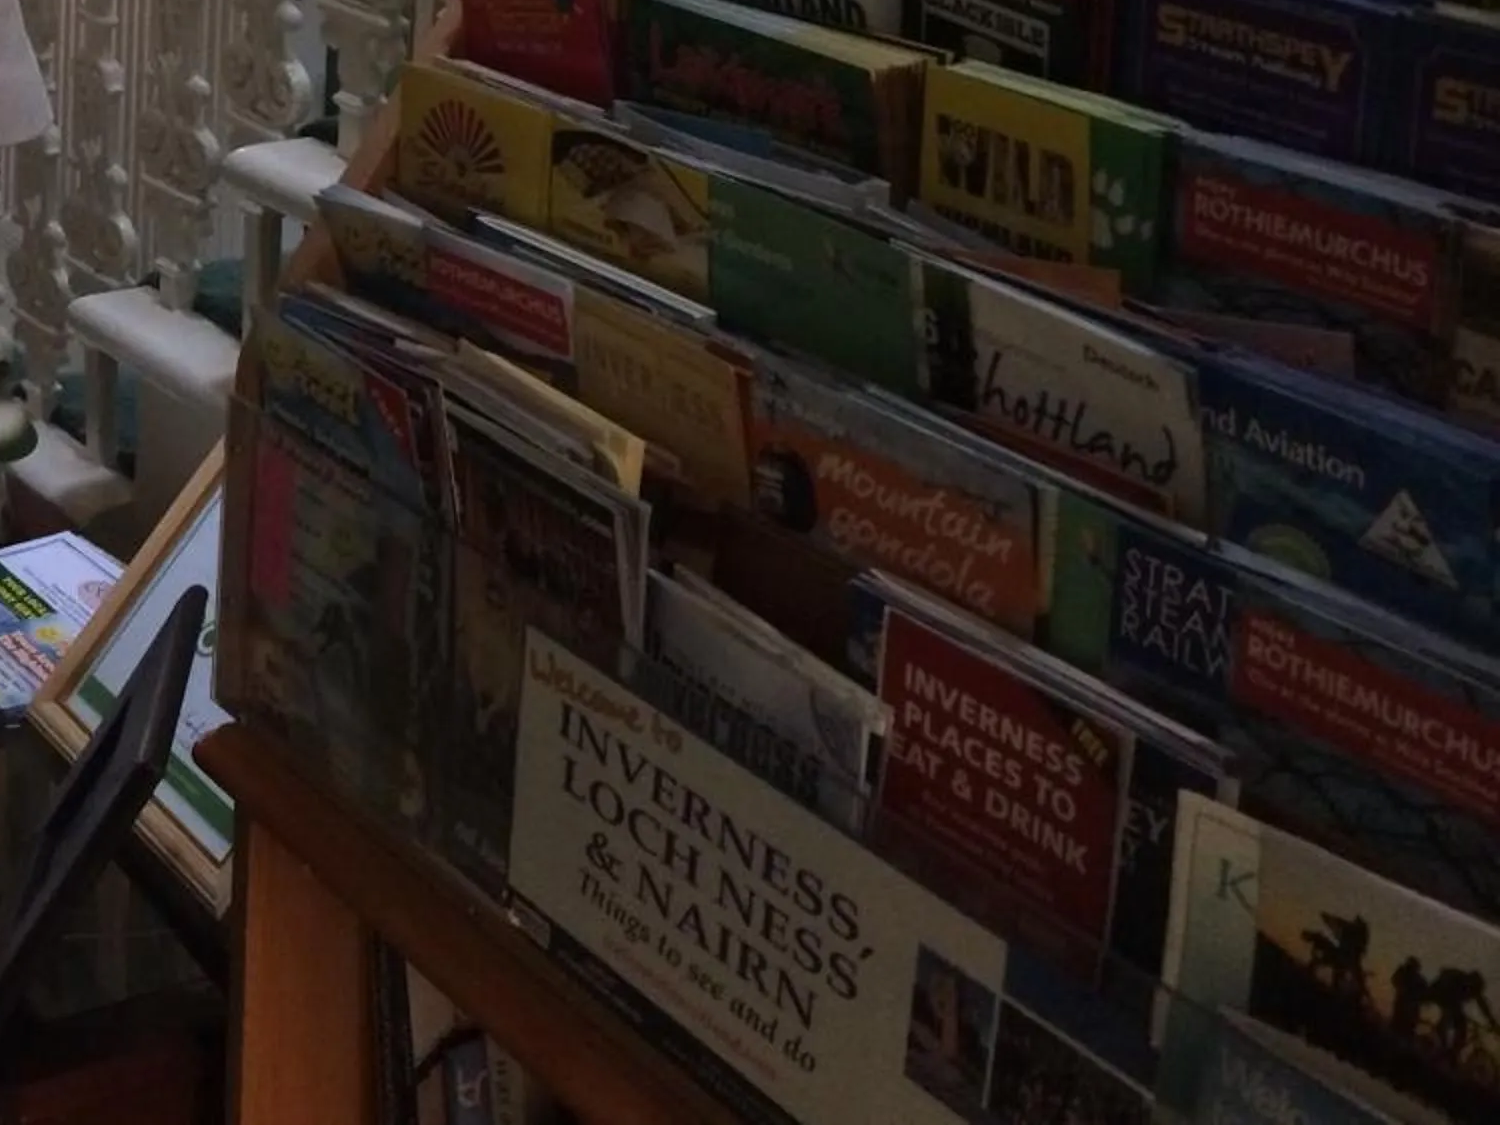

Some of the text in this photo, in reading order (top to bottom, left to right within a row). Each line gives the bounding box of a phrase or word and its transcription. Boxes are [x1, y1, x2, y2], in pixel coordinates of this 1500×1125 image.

[1194, 192, 1429, 287] ROTHIEMURCHUS
[817, 452, 1012, 564] Mountain
[1244, 419, 1365, 491] Aviation
[904, 663, 1085, 786] INVERNESS
[904, 700, 1022, 791] PLACES
[1032, 772, 1076, 823] TO
[890, 733, 1089, 876] EAT & DRINK
[562, 755, 699, 888] LOCH
[715, 864, 858, 1002] NESS
[587, 831, 622, 884] &
[635, 864, 818, 1031] NAIRN
[581, 871, 650, 943] Things
[658, 934, 683, 968] to
[688, 963, 727, 1002] see
[730, 997, 778, 1043] and
[782, 1035, 816, 1074] do
